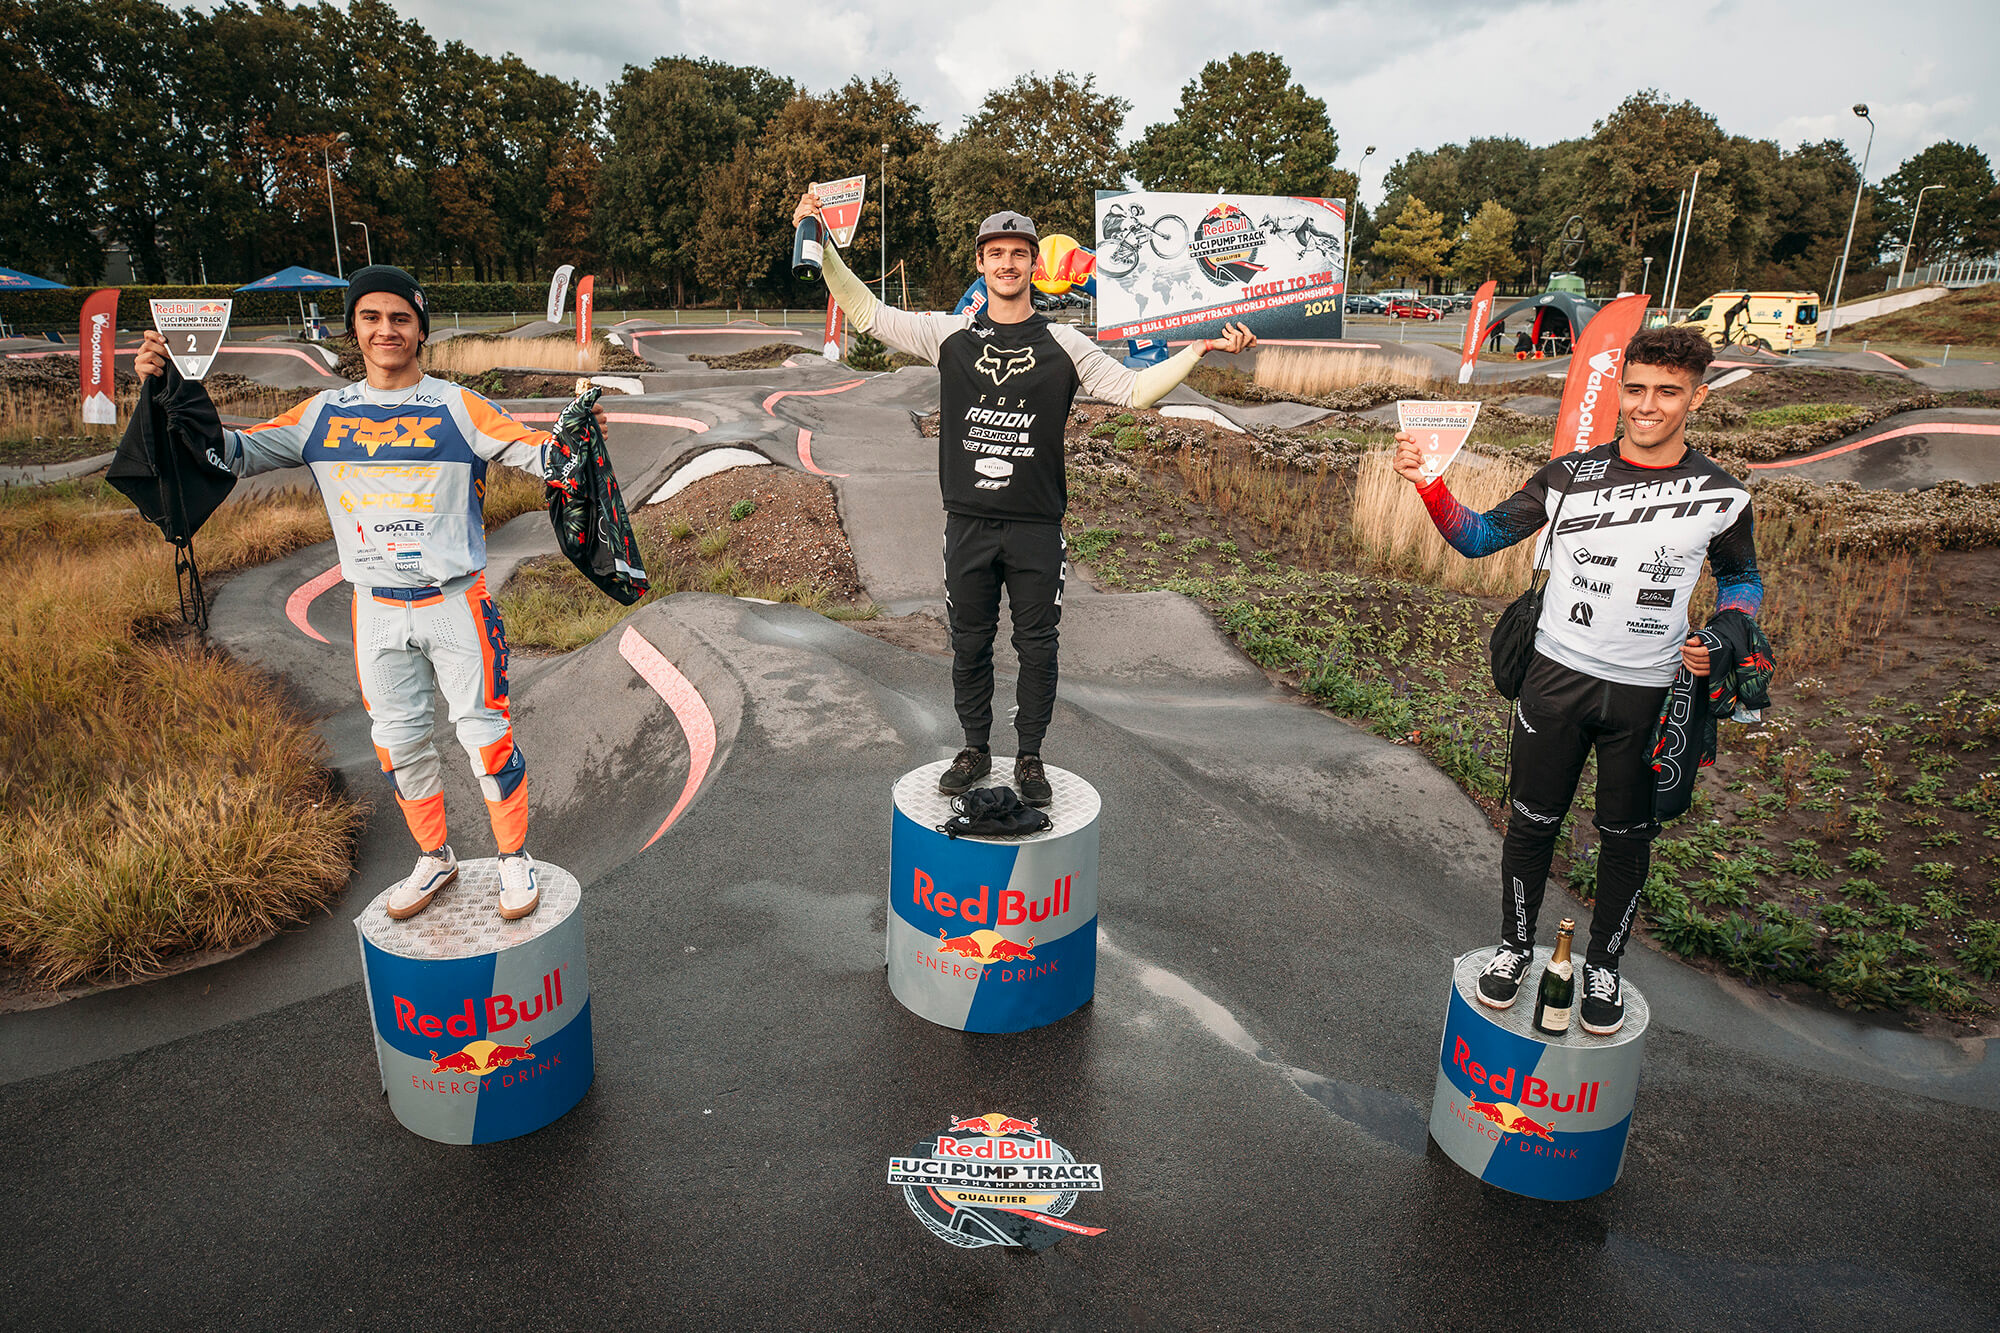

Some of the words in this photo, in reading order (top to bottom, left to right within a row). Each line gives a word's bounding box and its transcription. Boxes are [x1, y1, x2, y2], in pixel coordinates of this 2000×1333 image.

[838, 209, 843, 224] 1
[1204, 221, 1225, 236] Red
[1226, 217, 1247, 232] Bull
[1193, 241, 1210, 250] UCI
[1212, 236, 1236, 248] PUMP
[1238, 231, 1264, 242] TRACK
[1242, 282, 1284, 298] TICKET
[1288, 276, 1306, 290] TO
[1309, 271, 1332, 285] THE
[156, 304, 175, 313] Red
[177, 304, 194, 313] Bull
[963, 292, 985, 316] Bull
[1122, 325, 1140, 336] RED
[1142, 322, 1164, 333] BULL
[1166, 318, 1180, 328] UCI
[1182, 307, 1234, 324] PUMPTRACK
[1235, 301, 1266, 313] WORLD
[1267, 286, 1334, 308] CHAMPIONSHIPS
[1304, 300, 1336, 316] 2021
[1469, 300, 1488, 355] Velosolutions
[91, 313, 110, 384] Velosolutions
[187, 334, 196, 352] 2
[980, 394, 1026, 408] FOX
[1402, 406, 1420, 414] Red
[1422, 406, 1440, 414] Bull
[964, 407, 1036, 428] RADON
[970, 428, 982, 436] SR
[982, 429, 1017, 442] SUNTOUR
[1429, 434, 1438, 450] 3
[962, 440, 980, 450] VEE
[980, 442, 1011, 456] TIRE
[1012, 447, 1034, 456] CO.
[1594, 475, 1712, 506] KENNY
[360, 493, 436, 508] PRIDE
[374, 522, 424, 532] OPALE
[396, 562, 418, 570] Nord
[1590, 555, 1618, 567] odi
[1642, 564, 1668, 574] MASSY
[1669, 567, 1685, 576] BMX
[1572, 575, 1587, 589] ON
[1590, 582, 1611, 594] AIR
[1652, 574, 1670, 583] 91
[913, 868, 989, 924] Red
[997, 874, 1072, 925] Bull
[917, 950, 992, 981] ENERGY
[1002, 959, 1059, 982] DRINK
[393, 995, 478, 1038] Red
[484, 968, 563, 1034] Bull
[412, 1075, 491, 1094] ENERGY
[503, 1052, 562, 1088] DRINK
[1453, 1035, 1516, 1099] Red
[1520, 1075, 1599, 1113] Bull
[1450, 1102, 1512, 1146] ENERGY
[1520, 1141, 1579, 1159] DRINK
[938, 1137, 993, 1158] Red
[999, 1140, 1051, 1160] Bull
[902, 1160, 946, 1175] UCI
[952, 1165, 1018, 1179] PUMP
[1024, 1166, 1099, 1180] TRACK
[894, 1175, 949, 1184] WORLD
[960, 1180, 1098, 1188] CHAMPIONSHIPS
[958, 1192, 1027, 1204] QUALIFIER
